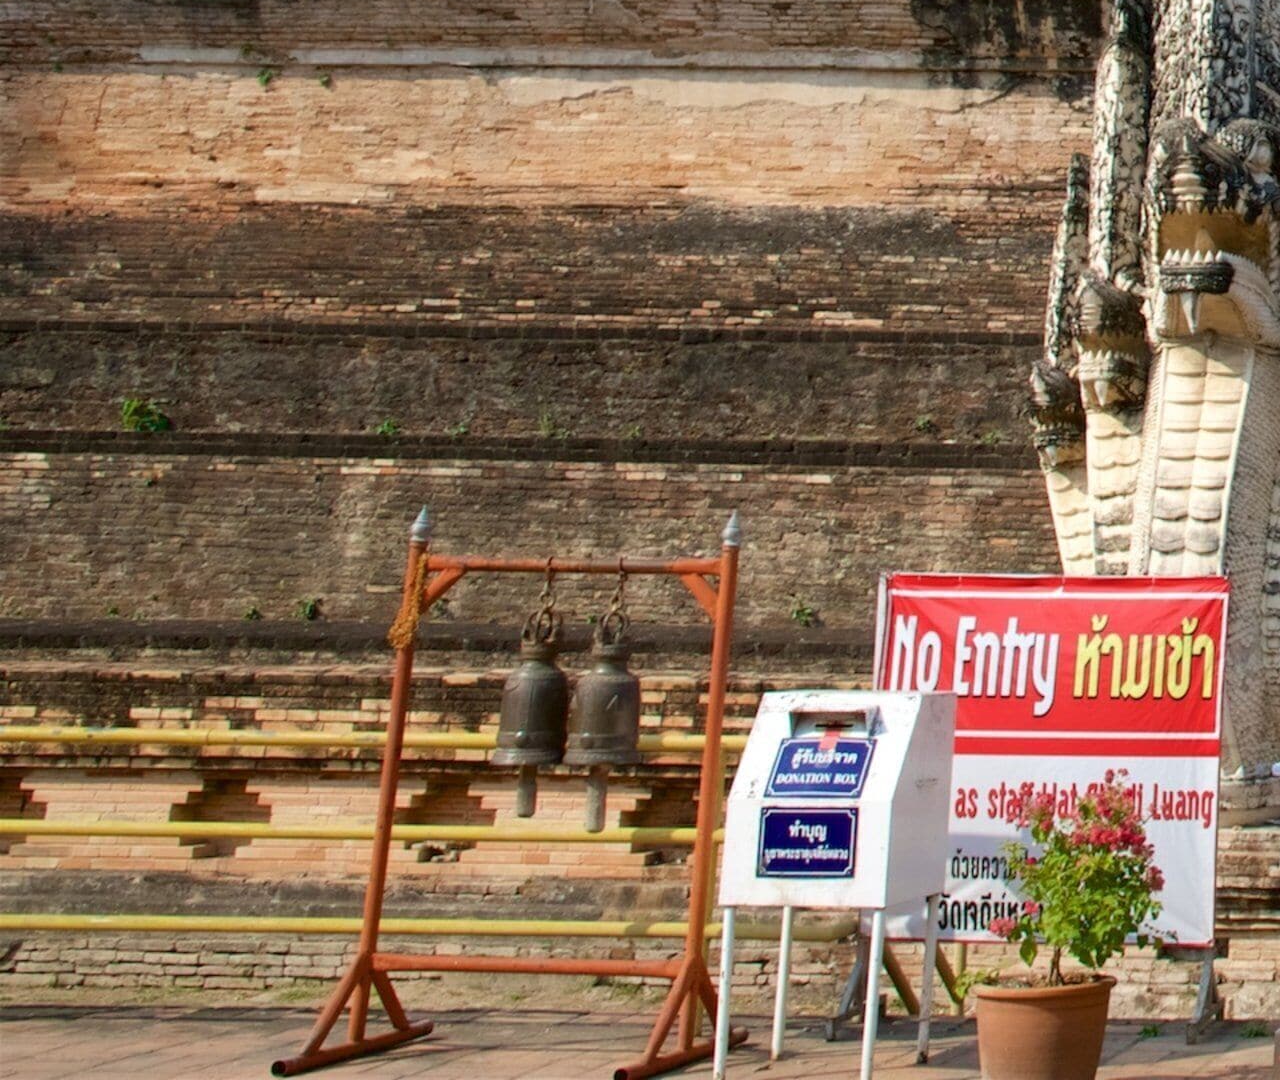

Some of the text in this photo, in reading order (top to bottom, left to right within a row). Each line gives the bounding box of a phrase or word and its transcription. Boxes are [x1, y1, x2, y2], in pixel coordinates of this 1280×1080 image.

[890, 614, 1214, 717] No Entry ห้ามเข้า
[775, 773, 857, 784] DONATION BOX
[1152, 783, 1214, 828] Luang
[788, 819, 827, 843] ทำบุญ
